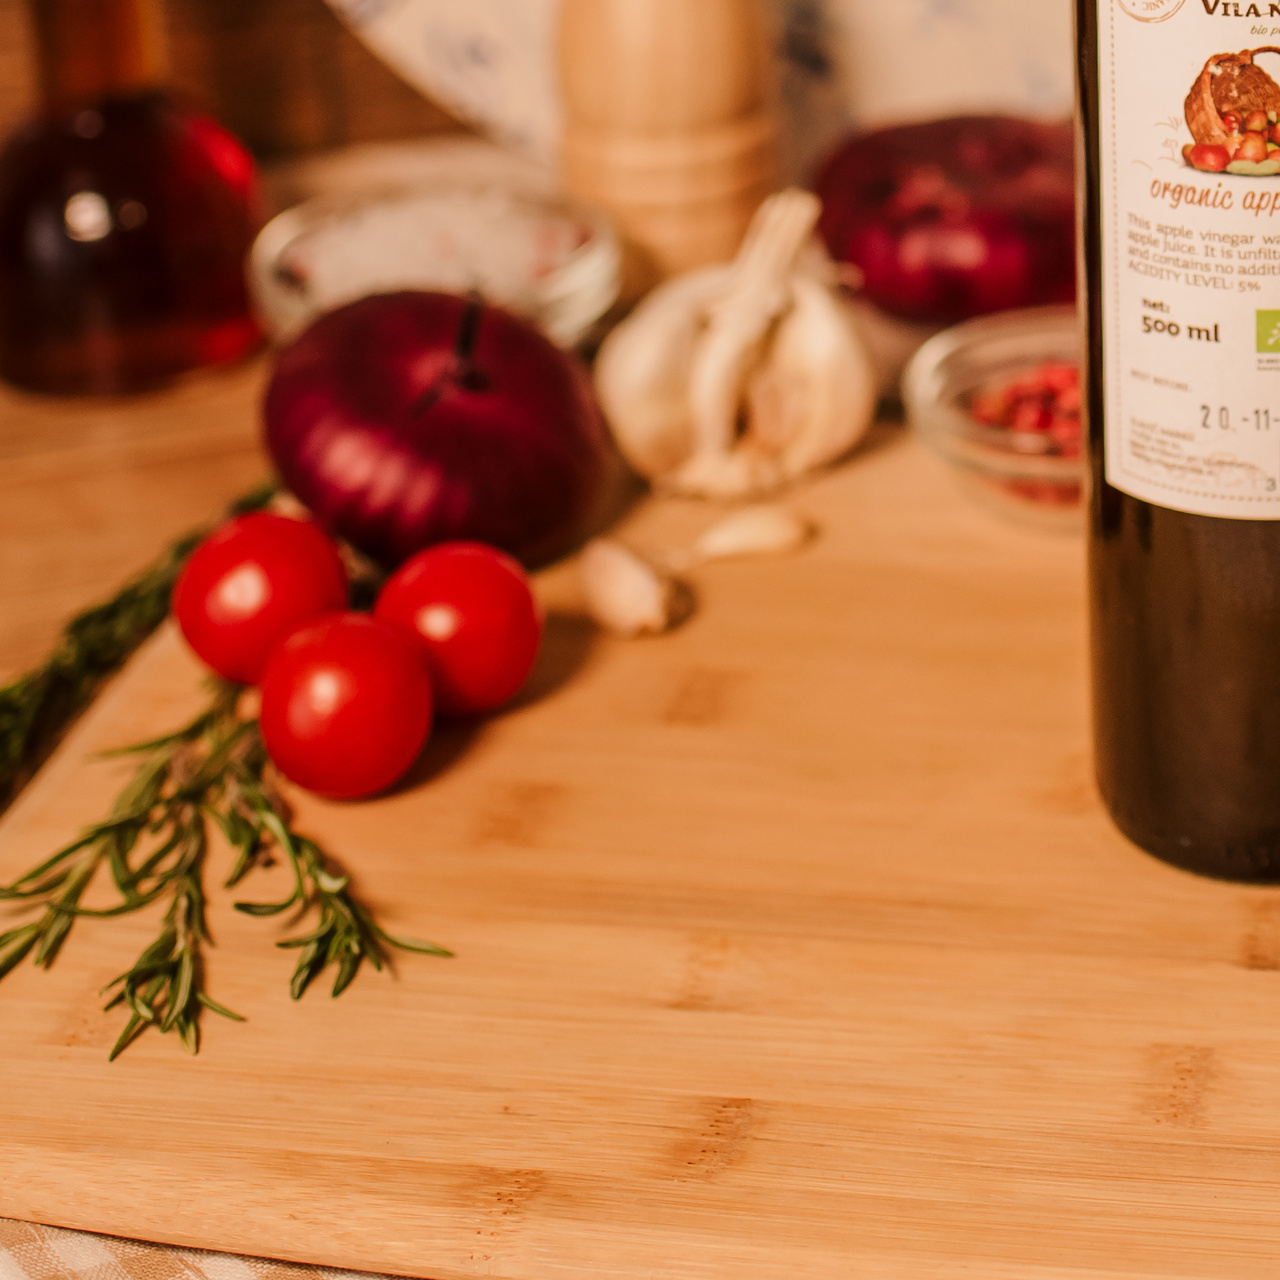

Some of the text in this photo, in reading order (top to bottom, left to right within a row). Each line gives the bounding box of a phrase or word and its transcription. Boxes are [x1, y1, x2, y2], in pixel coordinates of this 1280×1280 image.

[1250, 24, 1267, 35] bio
[1151, 178, 1234, 210] organic
[1127, 212, 1151, 230] This
[1156, 223, 1193, 239] apple
[1199, 231, 1255, 247] vinegar
[1128, 230, 1160, 247] apple
[1204, 245, 1216, 258] It
[1221, 247, 1233, 259] is
[1128, 246, 1149, 261] and
[1152, 253, 1211, 273] contains
[1215, 262, 1234, 275] no
[1128, 260, 1261, 293] ACIDITY LEVEL: 5%
[1142, 315, 1220, 342] 500 ml
